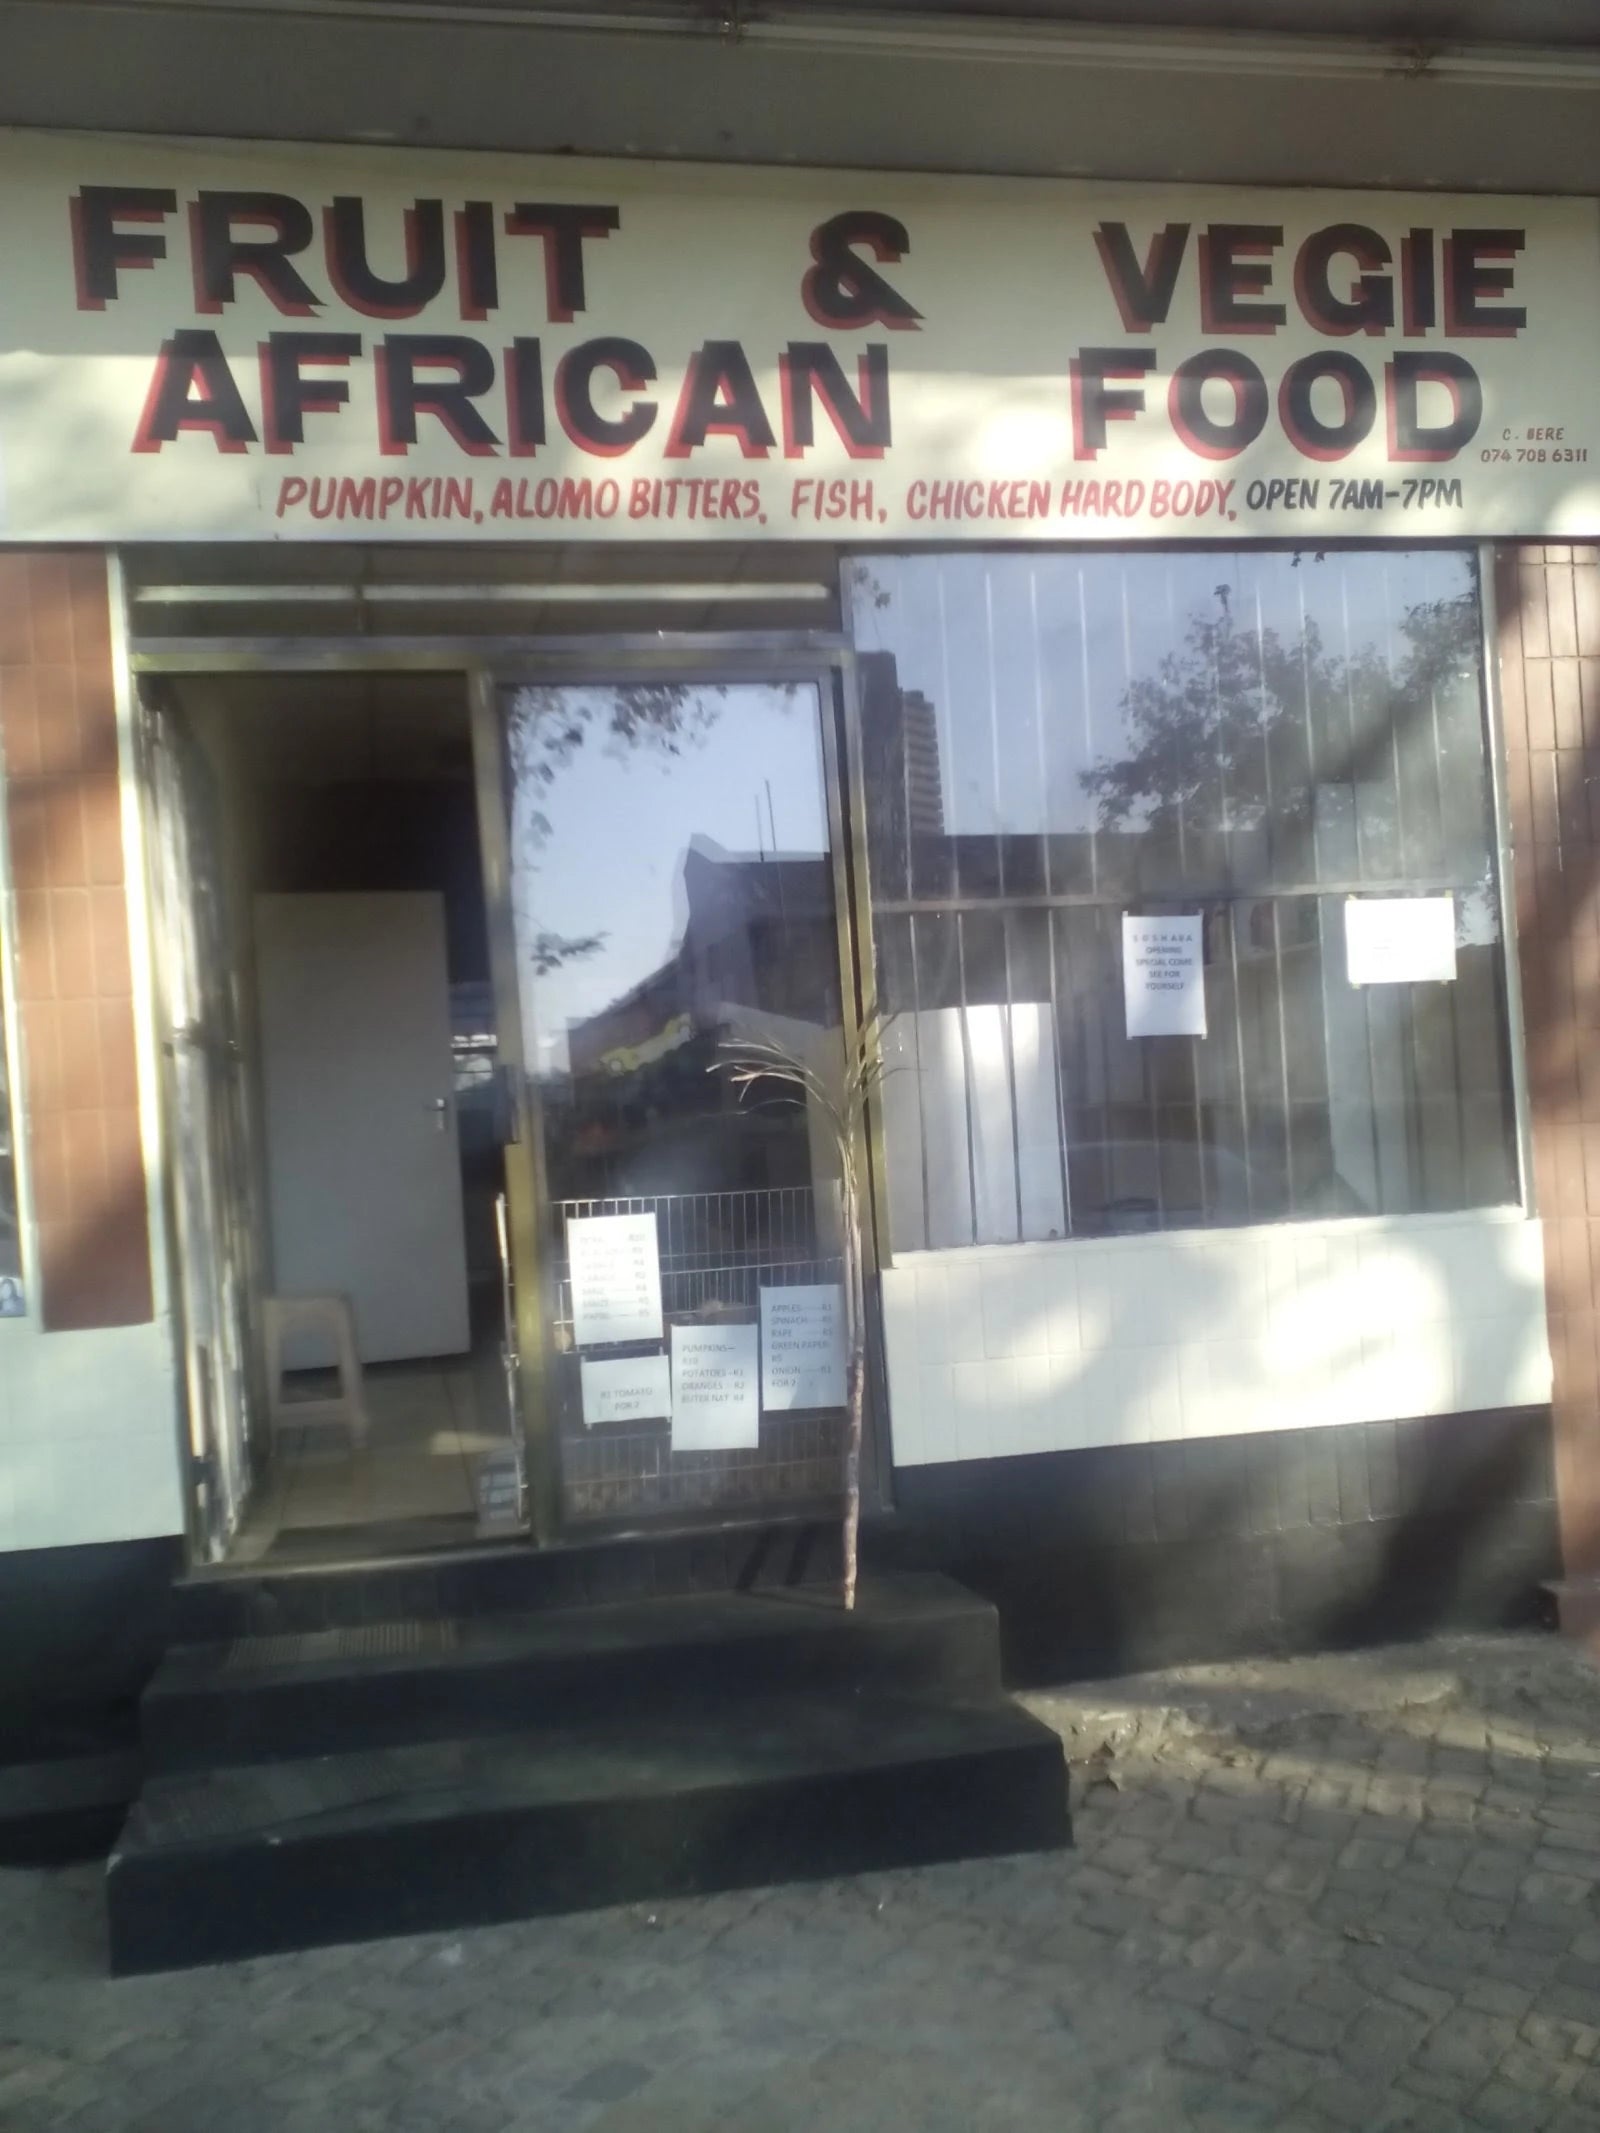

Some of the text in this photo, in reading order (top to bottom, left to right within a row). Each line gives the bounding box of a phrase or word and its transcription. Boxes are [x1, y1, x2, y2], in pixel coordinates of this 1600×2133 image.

[68, 185, 1527, 338] FRUIT & VEGIE
[131, 329, 1483, 463] AFRICAN FOOD
[1481, 448, 1588, 463] 074 708 6311
[276, 476, 1463, 525] PUMPKIN, ALOMO BITTERS, FISH, CHICKEN HARD BODY, OPEN 7AM-7PM
[1144, 982, 1185, 991] YOURSELF
[1164, 970, 1181, 978] FOR
